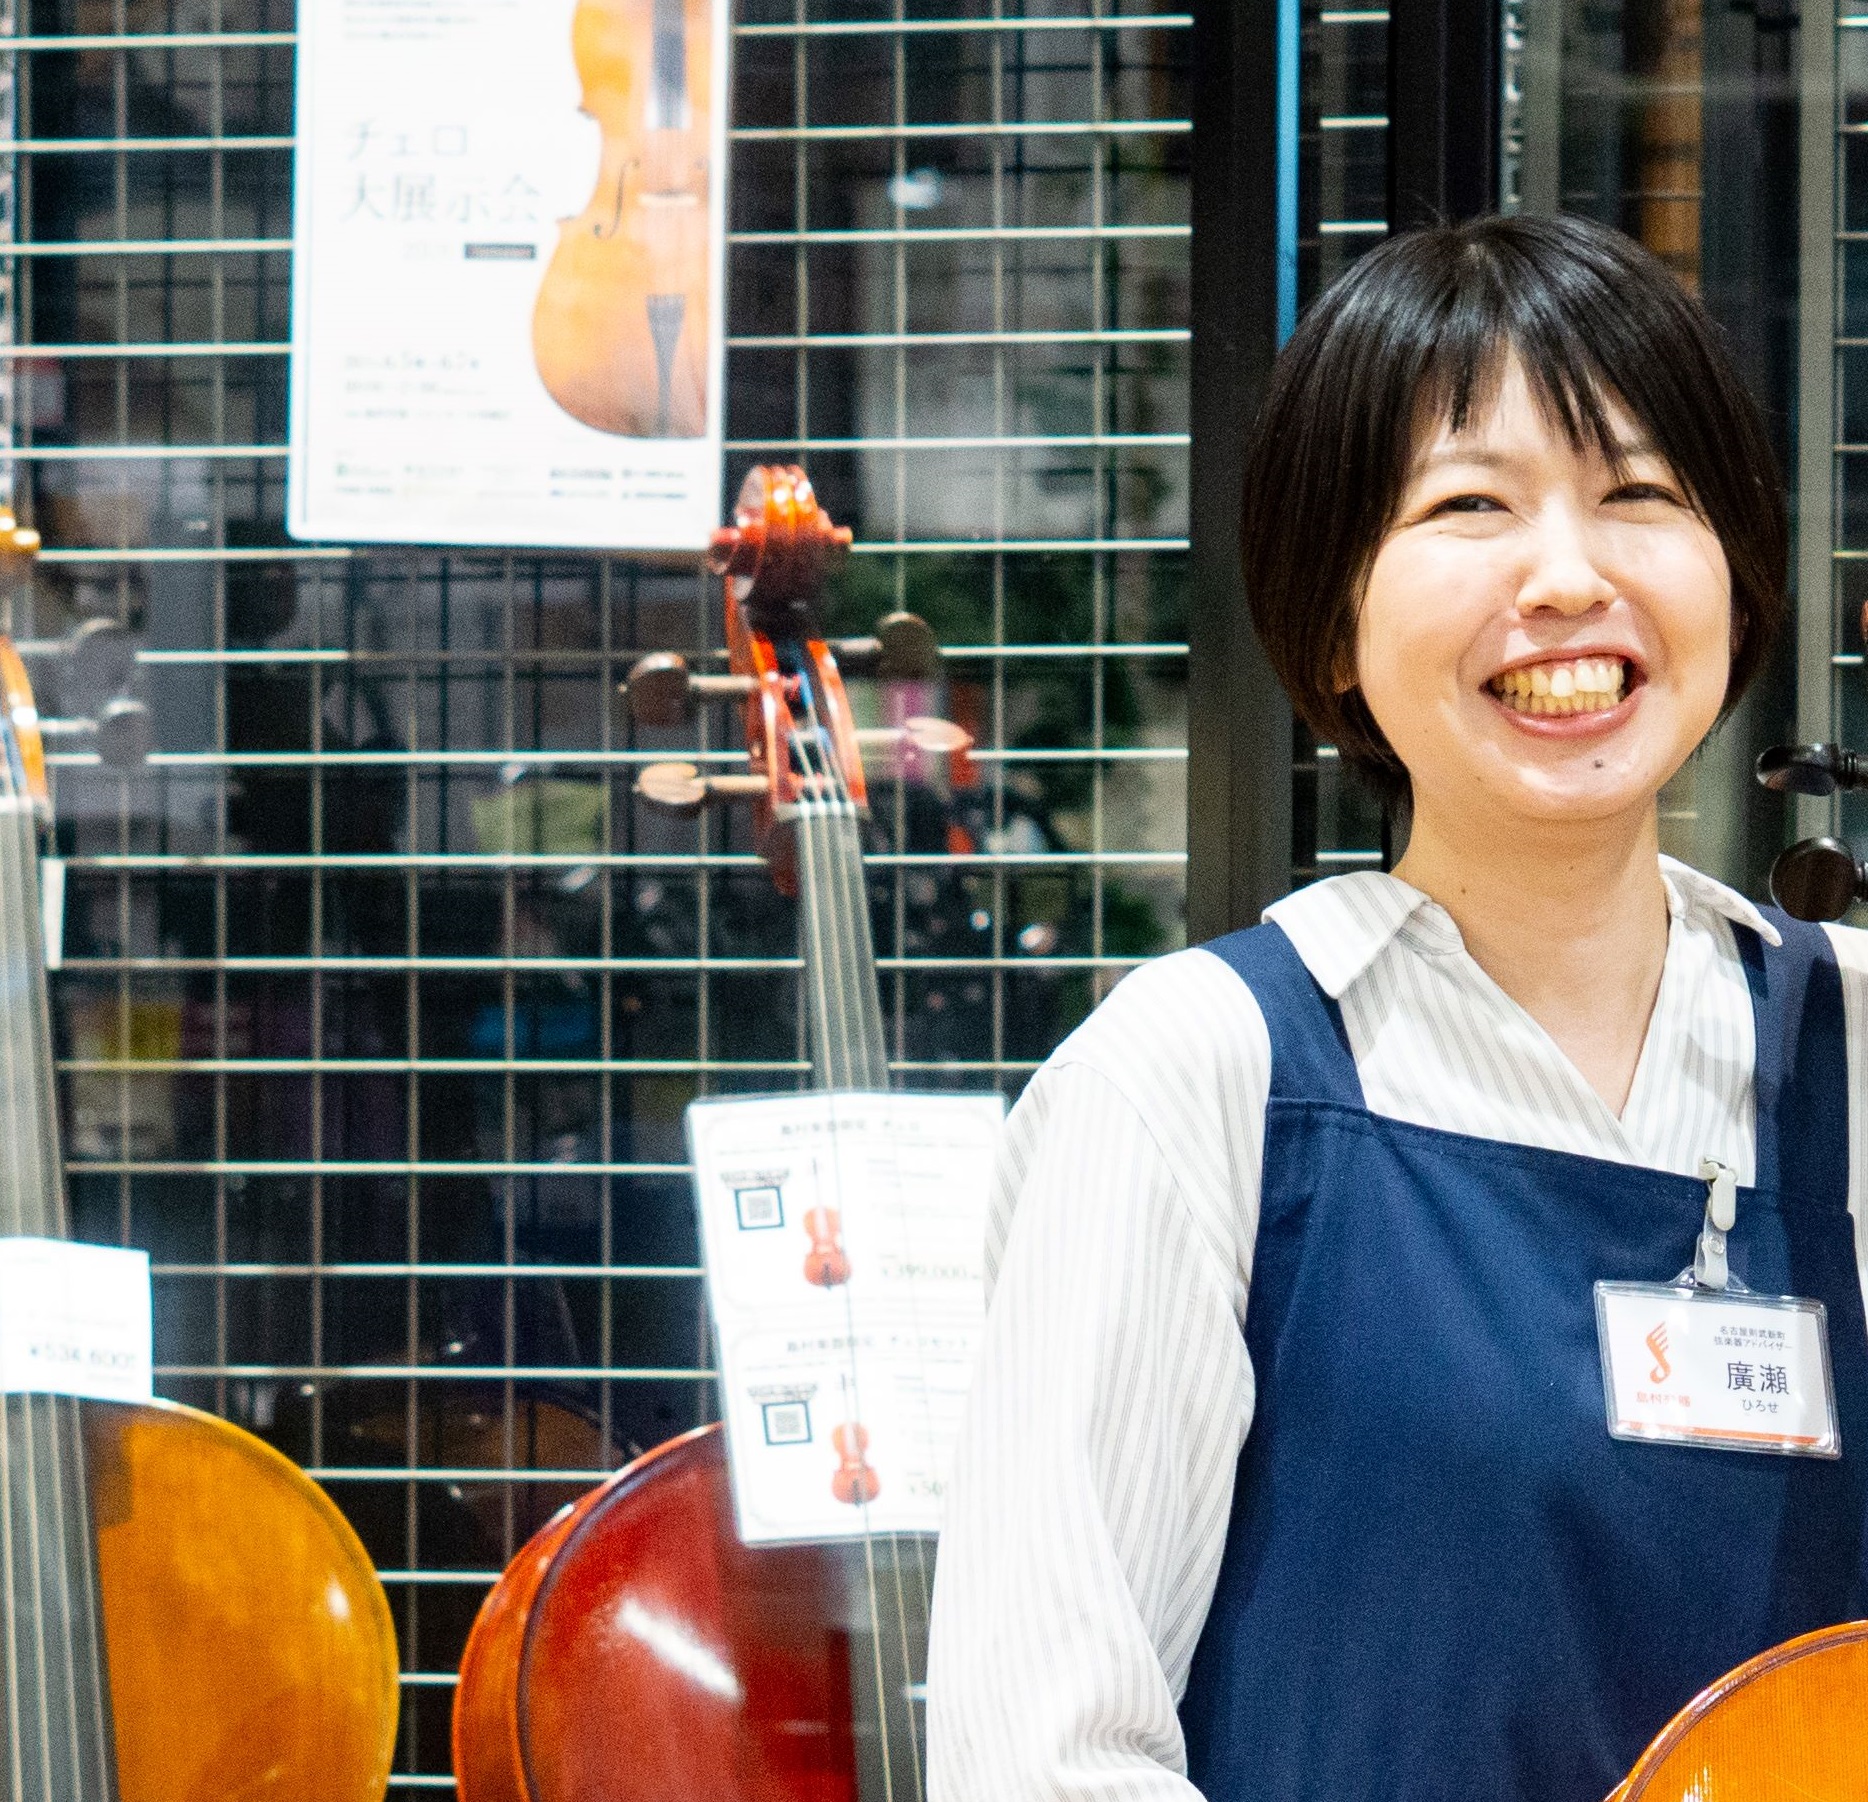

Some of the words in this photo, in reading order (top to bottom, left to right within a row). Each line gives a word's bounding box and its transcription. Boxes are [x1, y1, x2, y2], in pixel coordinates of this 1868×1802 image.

[342, 117, 469, 162] チェロ
[339, 172, 541, 225] 大展示会
[1726, 1360, 1791, 1396] 廣瀬
[1741, 1397, 1780, 1415] ひろせ
